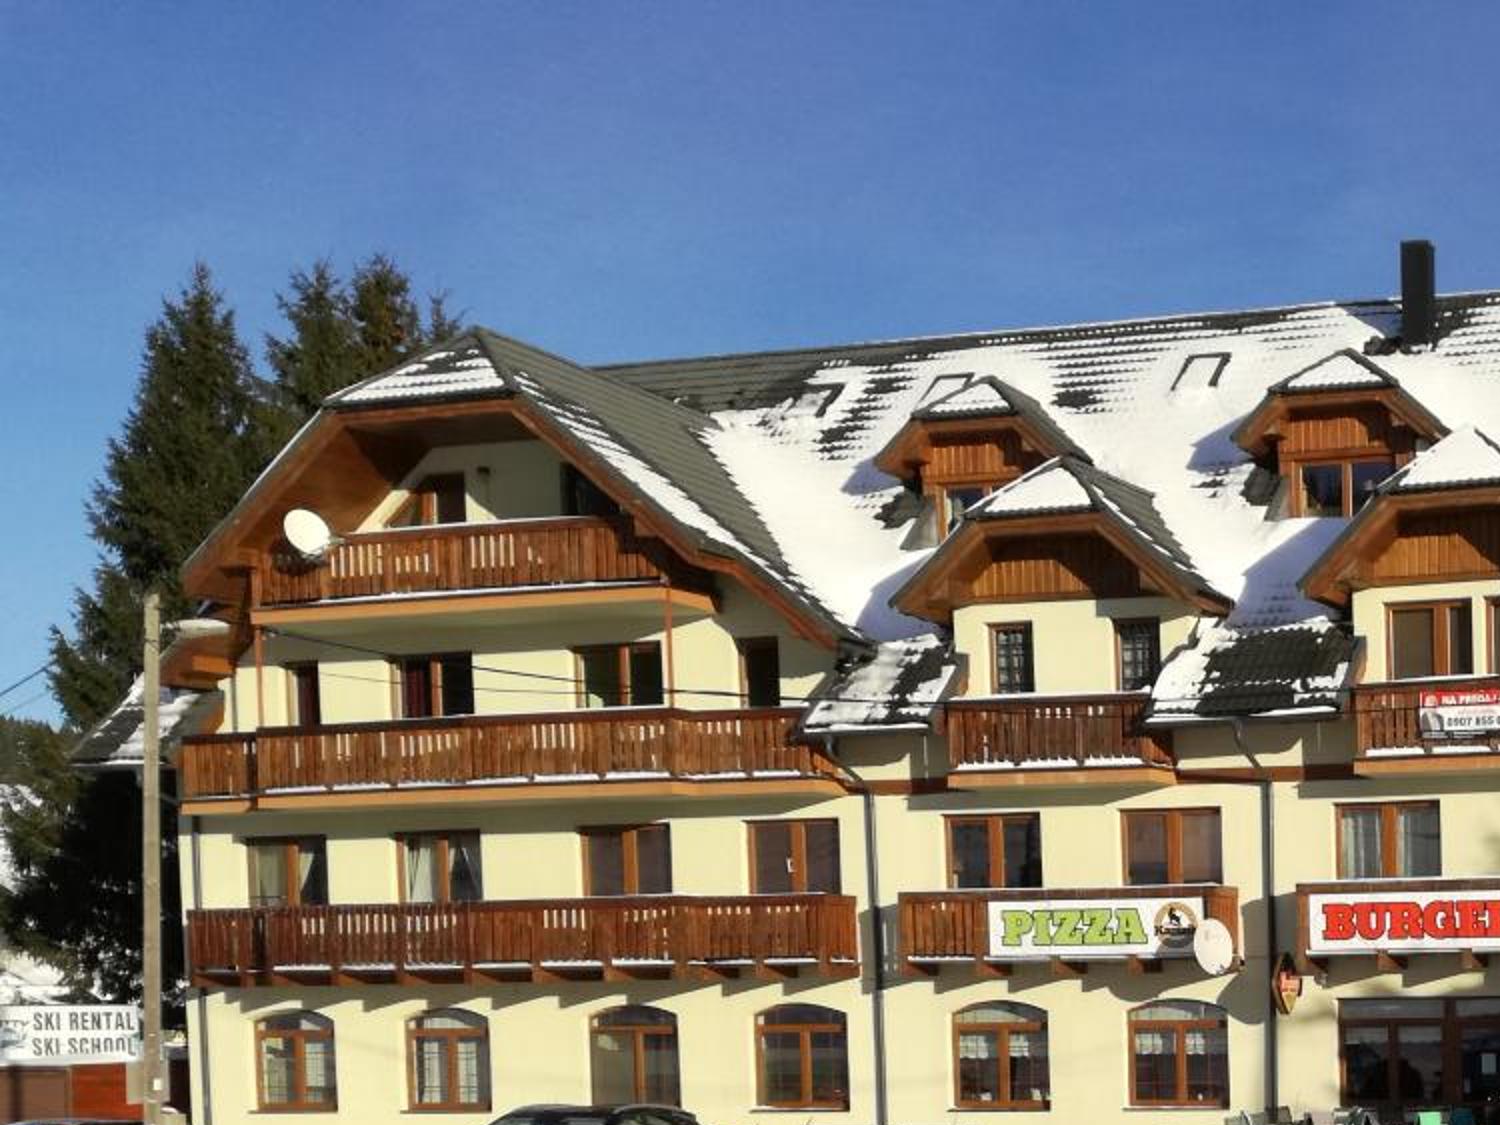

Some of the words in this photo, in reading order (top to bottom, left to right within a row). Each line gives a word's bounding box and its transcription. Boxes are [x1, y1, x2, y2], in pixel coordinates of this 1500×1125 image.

[1001, 908, 1149, 946] PIZZA
[33, 1011, 61, 1031] SKI
[69, 1011, 135, 1031] RENTAL
[32, 1037, 60, 1056] SKI
[68, 1036, 136, 1056] SCHOOL
